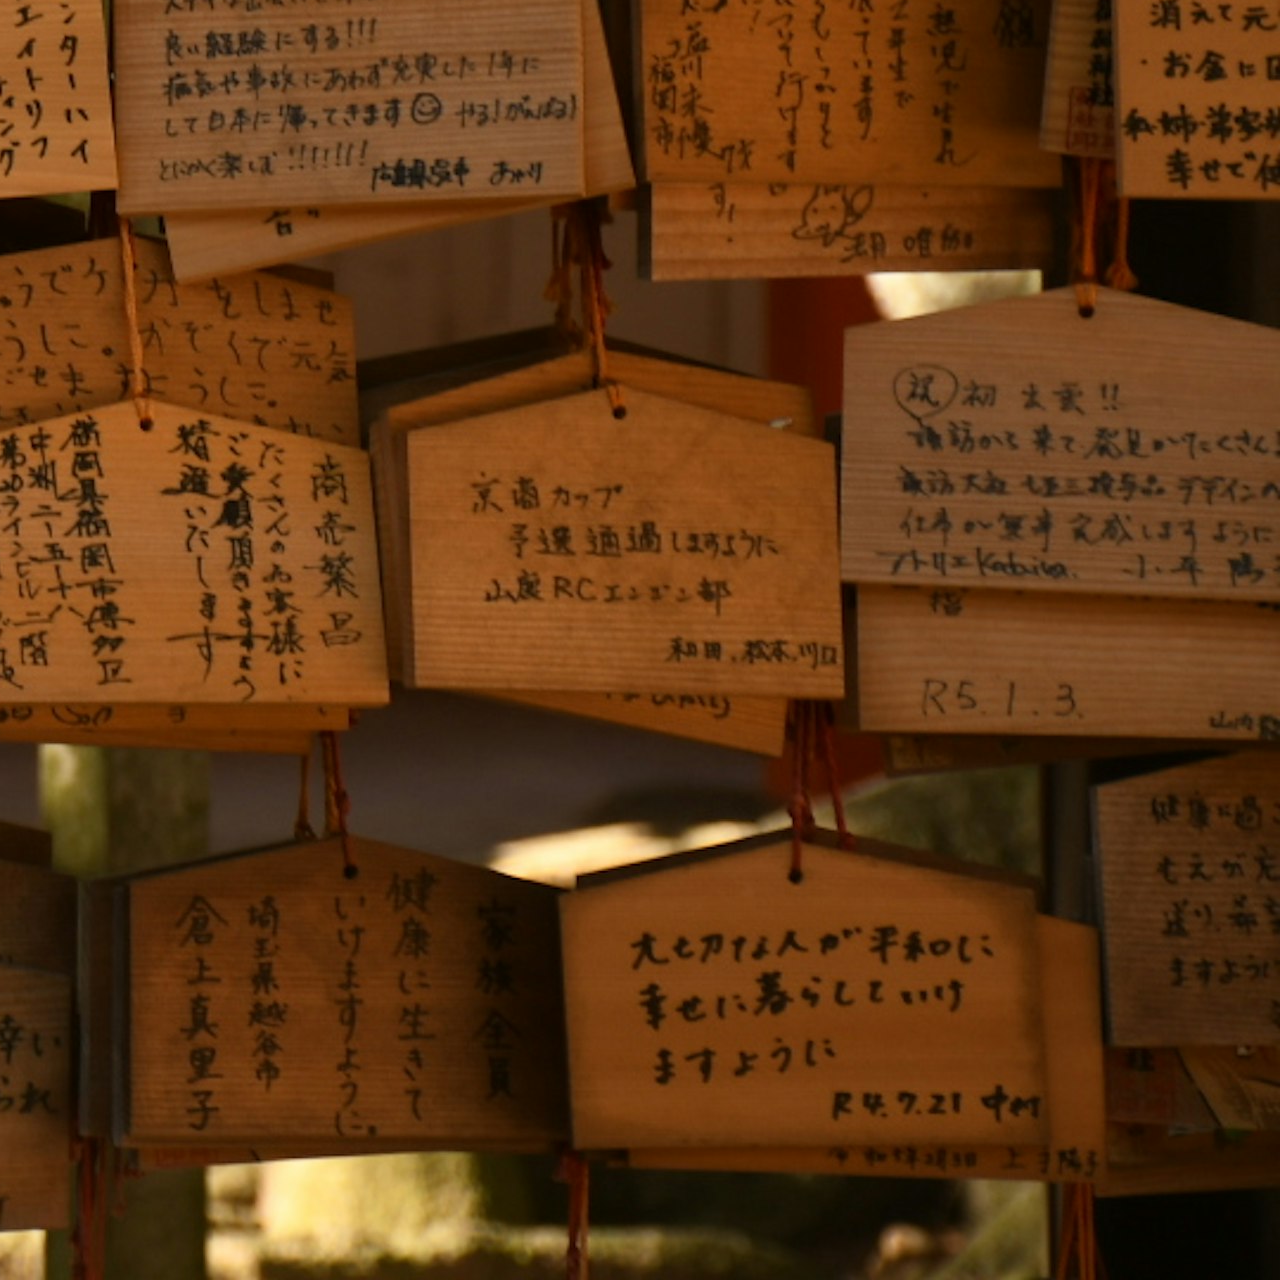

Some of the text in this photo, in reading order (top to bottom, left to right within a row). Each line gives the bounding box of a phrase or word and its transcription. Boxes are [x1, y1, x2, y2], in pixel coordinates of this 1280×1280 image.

[245, 894, 289, 1092] 埼玉県越谷市
[386, 866, 439, 1122] 健康に生きて
[470, 899, 523, 1102] 家族全員
[652, 1036, 838, 1086] ますように
